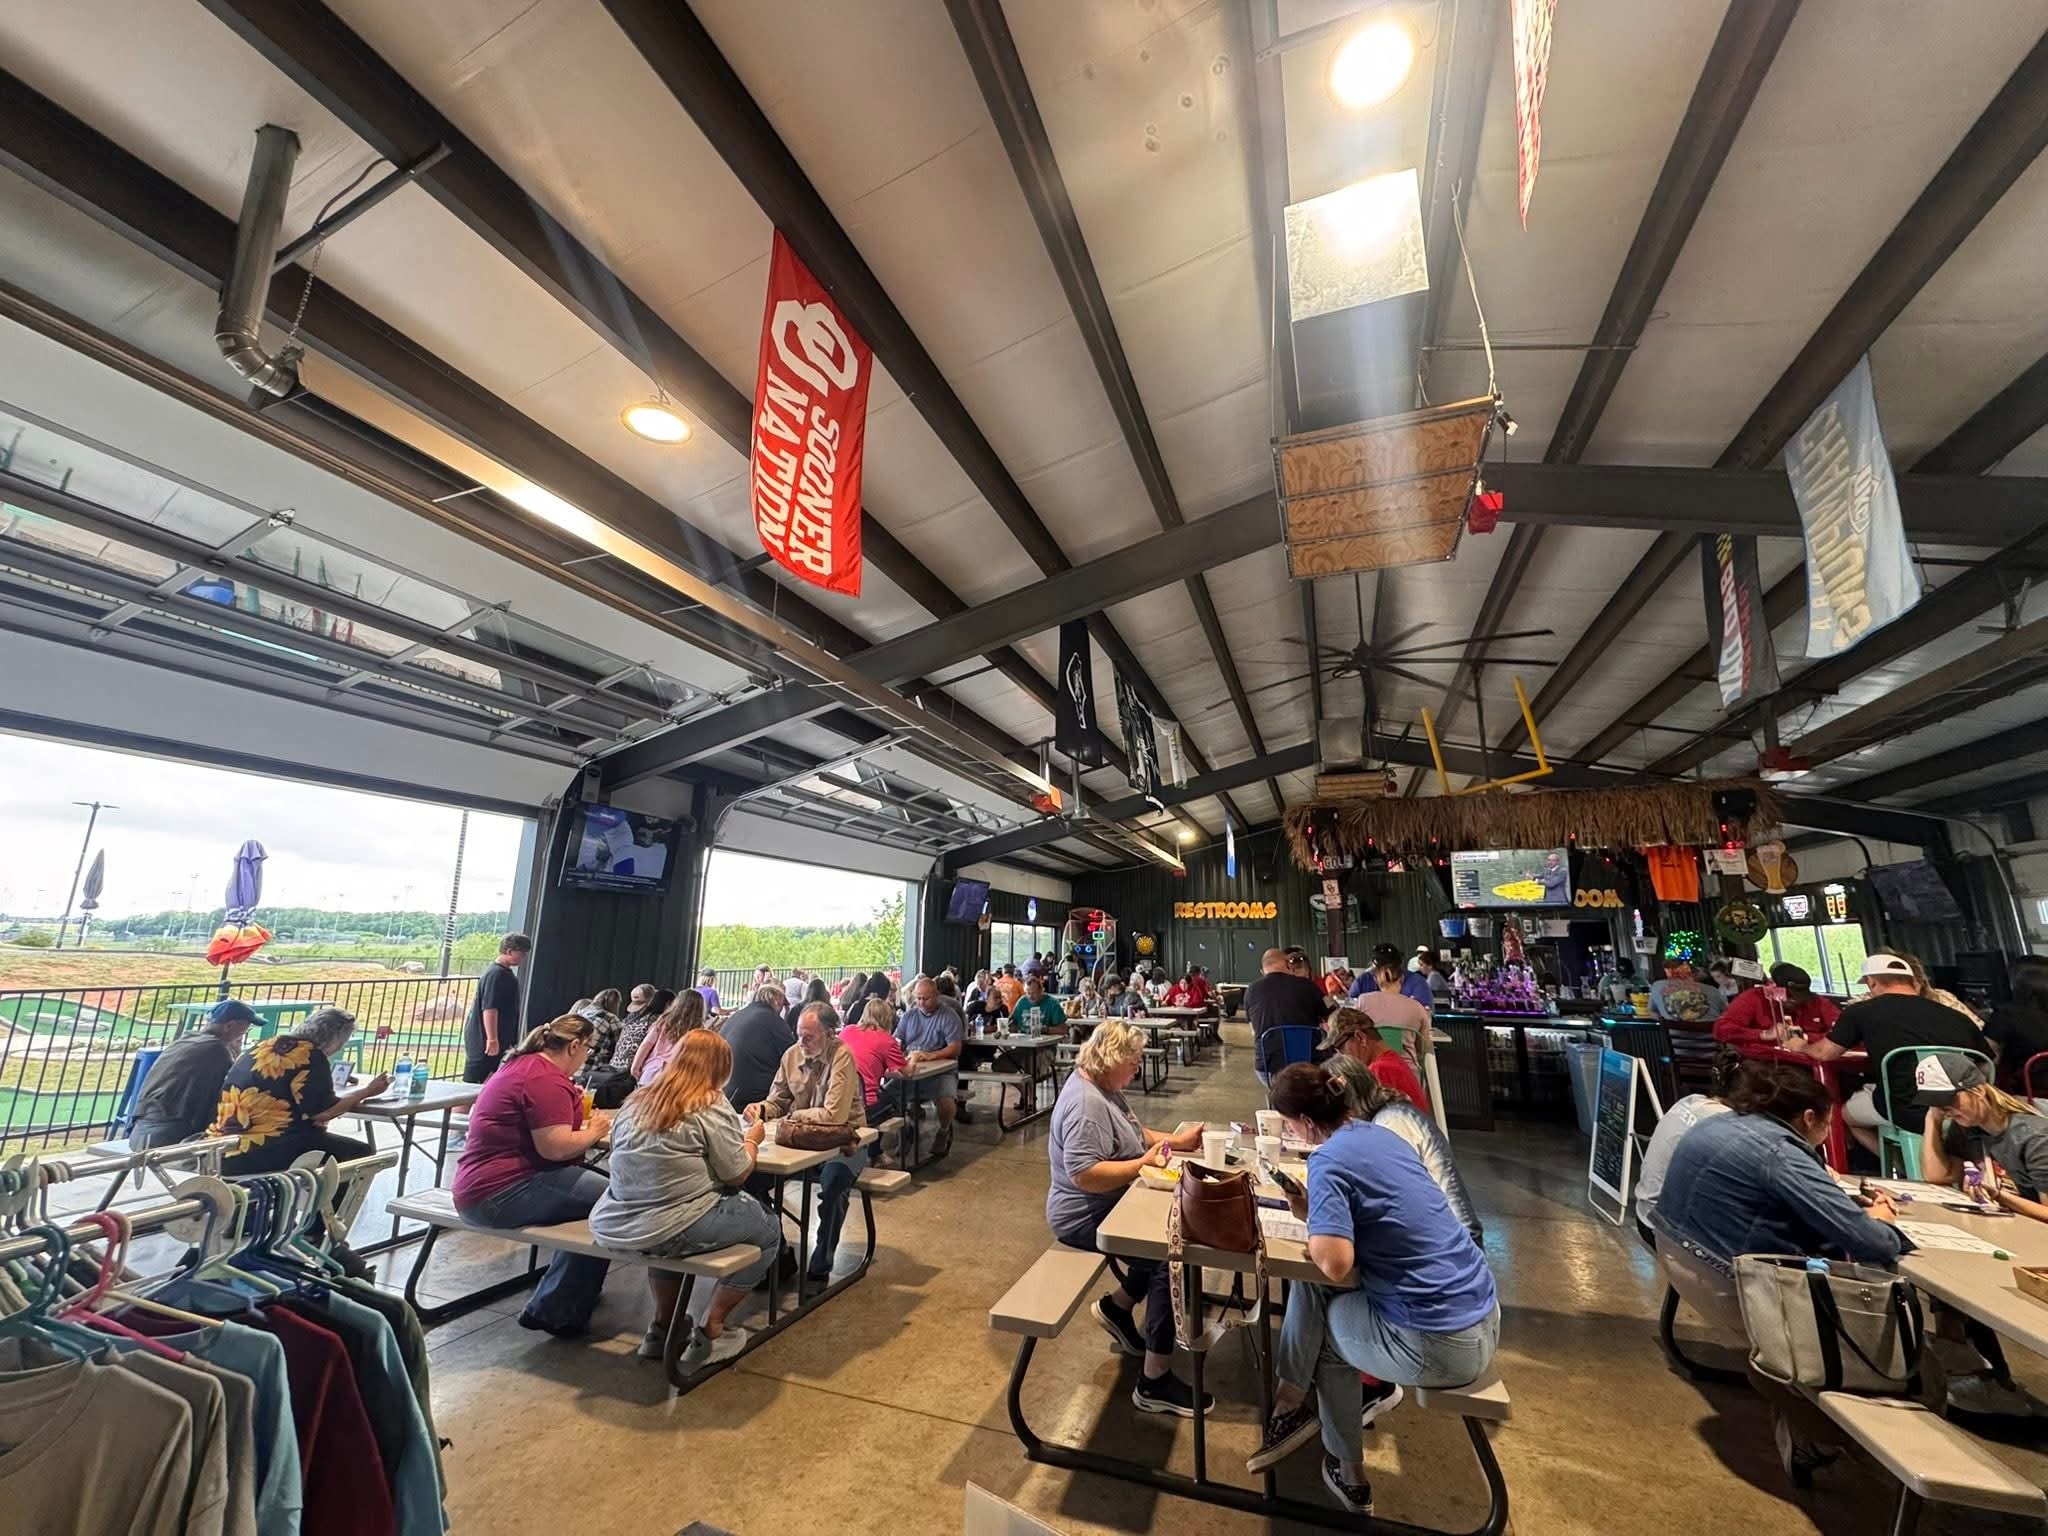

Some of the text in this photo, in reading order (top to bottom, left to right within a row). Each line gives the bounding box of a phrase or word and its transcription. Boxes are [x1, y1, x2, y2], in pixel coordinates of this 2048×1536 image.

[757, 368, 809, 555] NATION
[789, 406, 840, 576] SOONER
[1174, 901, 1278, 919] RESTROOMS
